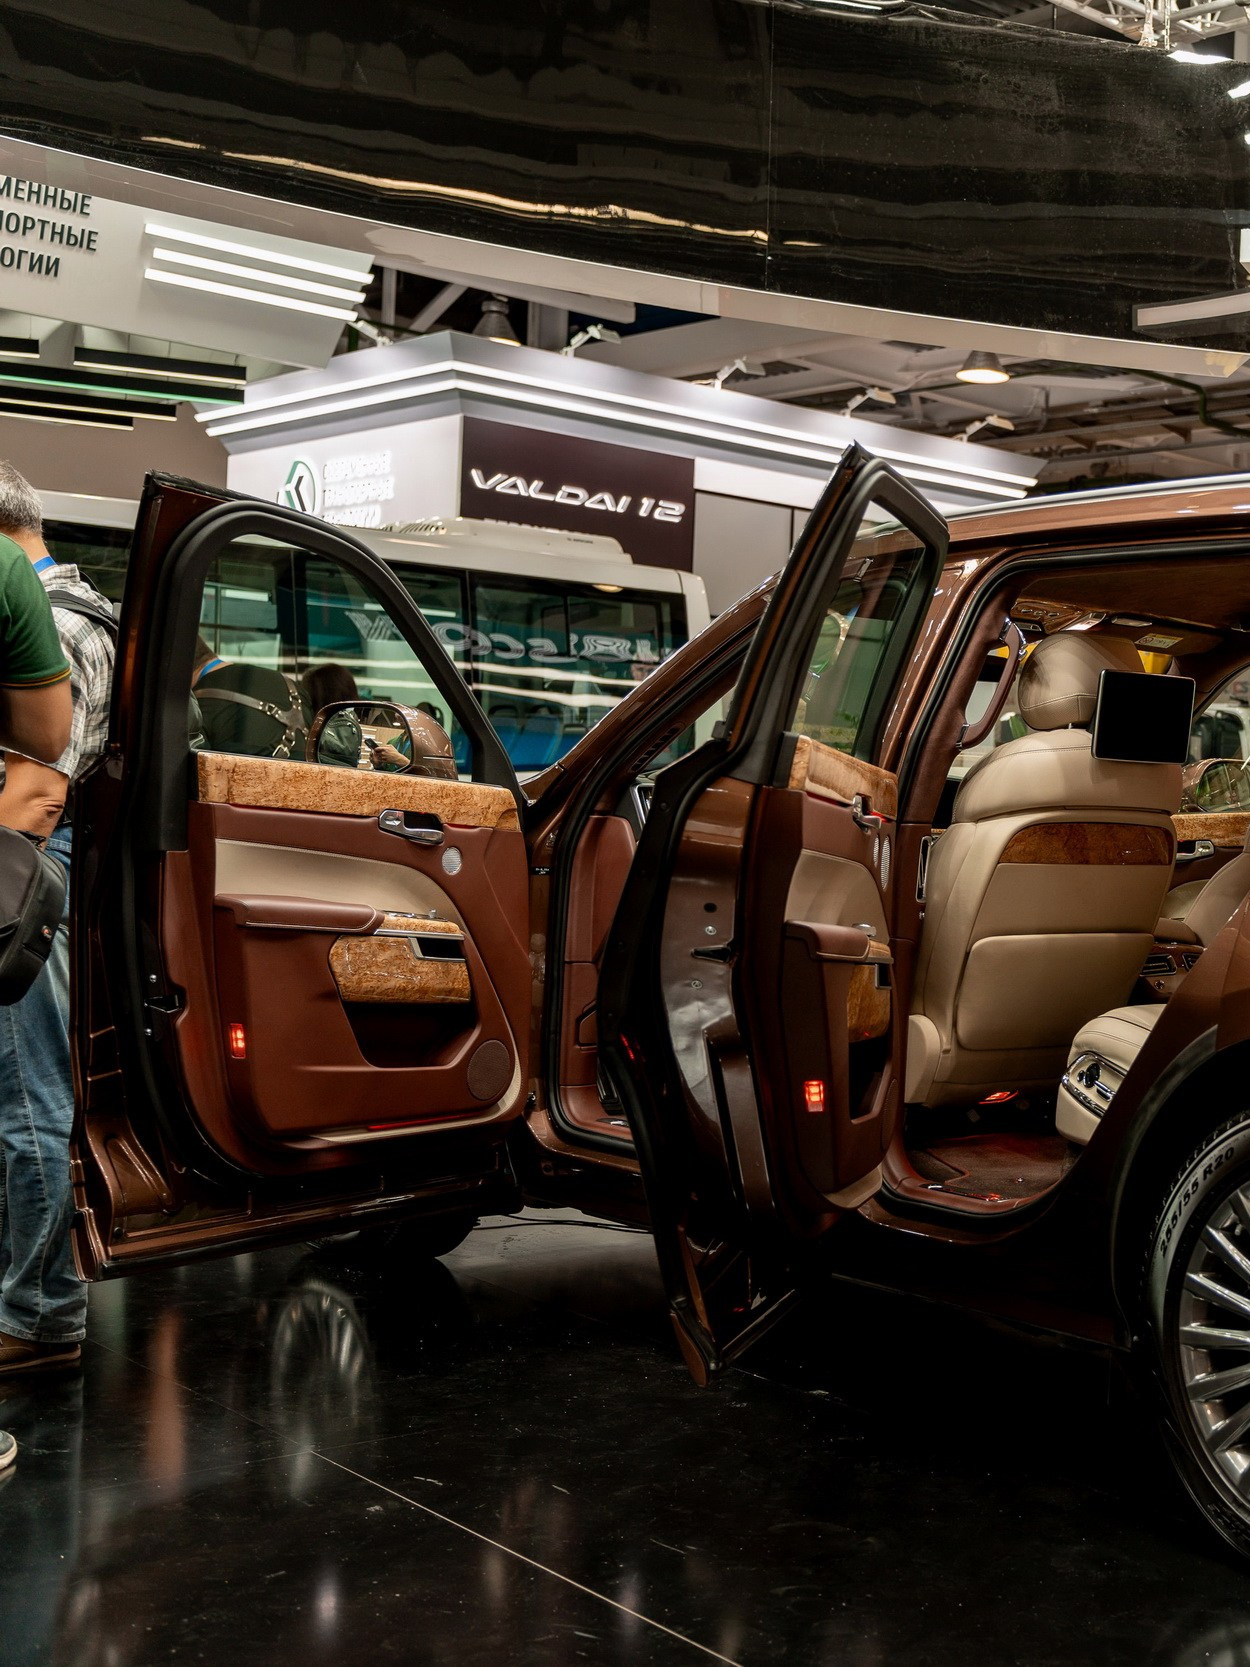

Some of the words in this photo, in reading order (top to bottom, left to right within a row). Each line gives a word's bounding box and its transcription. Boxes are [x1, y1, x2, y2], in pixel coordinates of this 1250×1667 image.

[0, 209, 98, 251] ОРТНЫЕ
[471, 468, 632, 514] VALDAI
[638, 496, 686, 523] 12
[1202, 1146, 1235, 1180] R20
